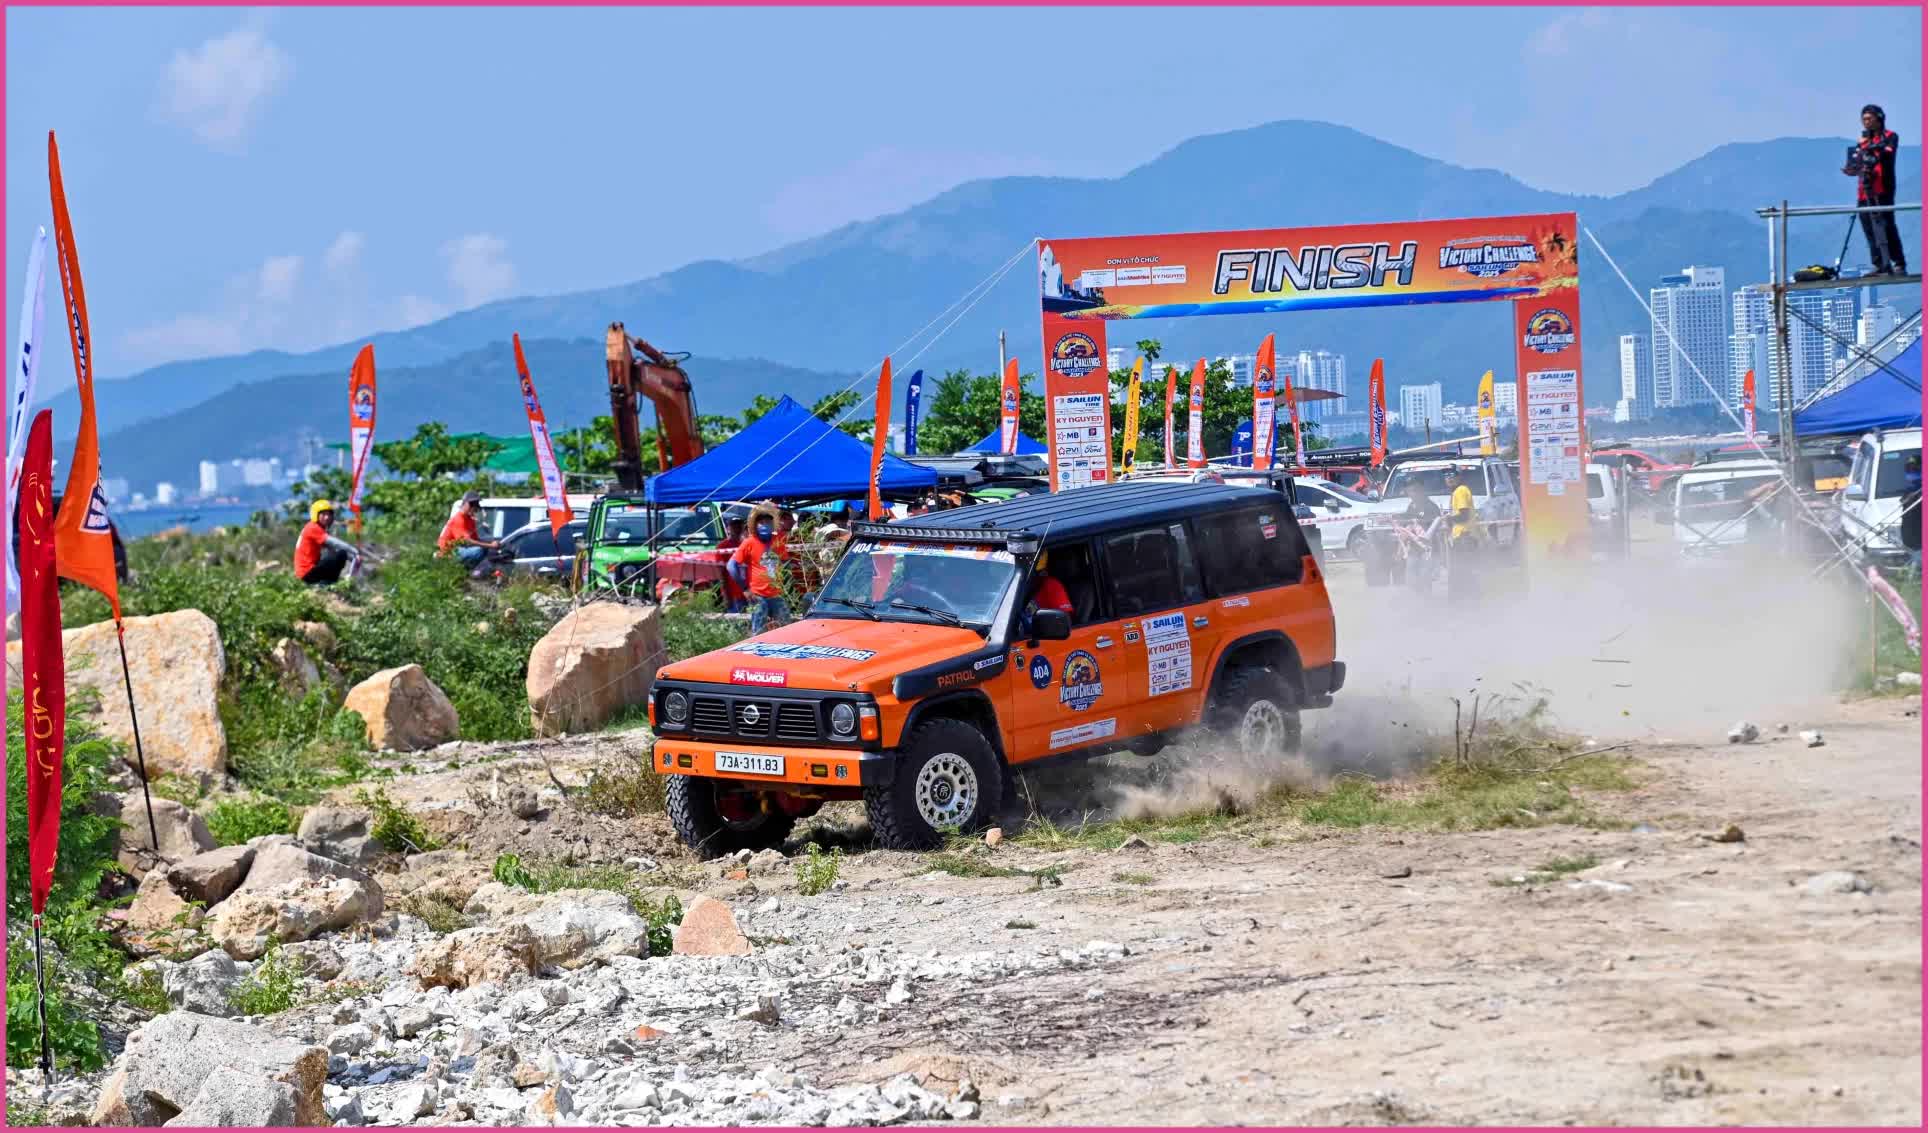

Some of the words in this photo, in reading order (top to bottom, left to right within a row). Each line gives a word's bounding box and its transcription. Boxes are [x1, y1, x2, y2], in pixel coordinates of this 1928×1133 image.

[1440, 247, 1483, 267] VICTORY
[1484, 244, 1537, 263] CHALLENGE
[1214, 241, 1418, 295] FINISH
[1067, 395, 1101, 404] SAILUN
[852, 543, 872, 553] 404
[1153, 615, 1184, 629] SAILUN
[1126, 632, 1139, 641] ARB
[747, 671, 785, 684] WOLVER
[937, 670, 976, 688] PATROL
[1033, 664, 1050, 680] 404
[720, 755, 778, 772] 73A-311.83
